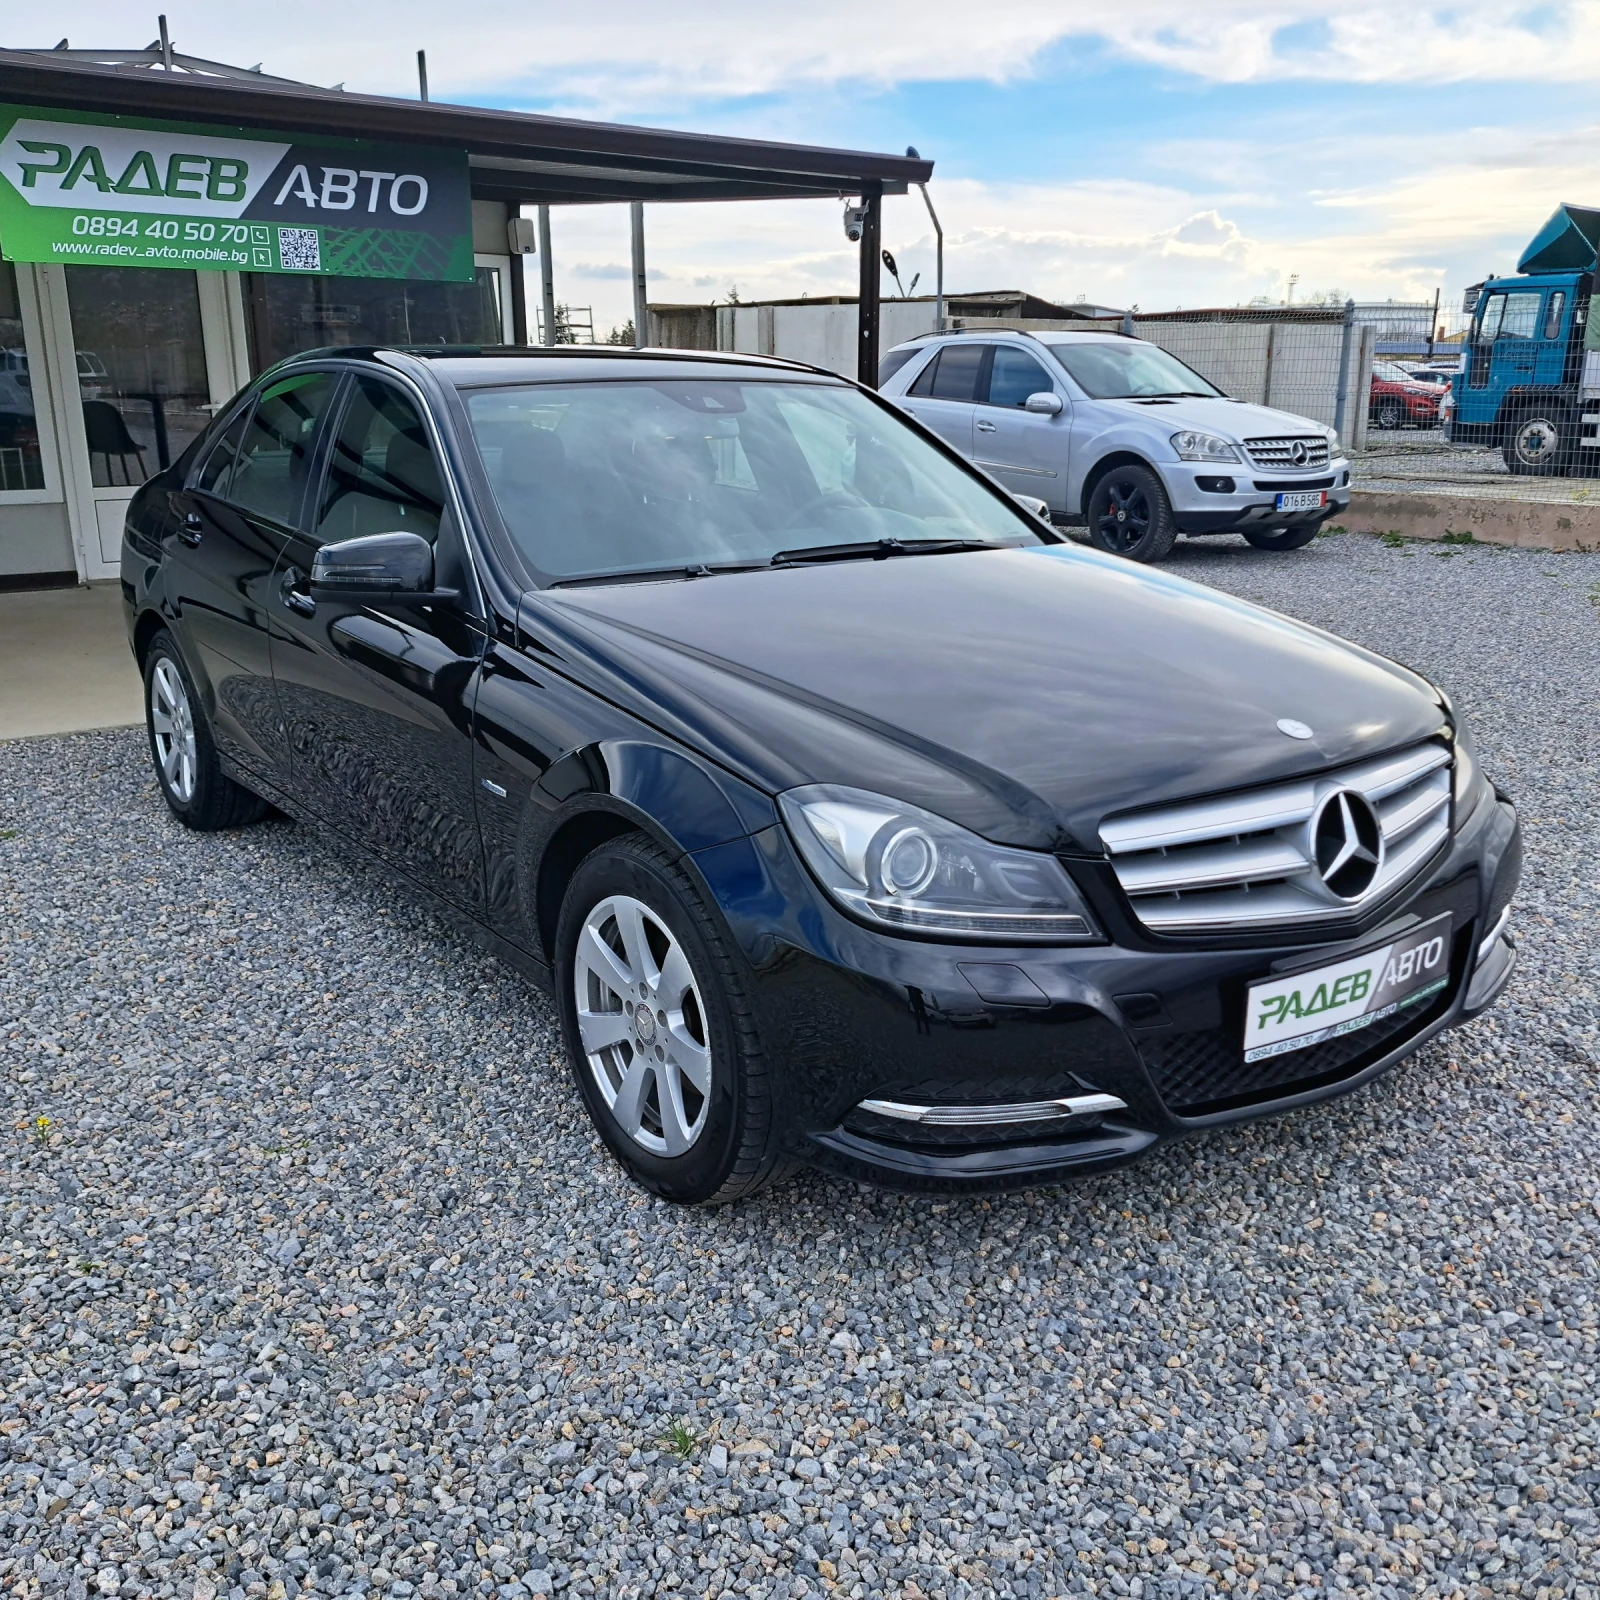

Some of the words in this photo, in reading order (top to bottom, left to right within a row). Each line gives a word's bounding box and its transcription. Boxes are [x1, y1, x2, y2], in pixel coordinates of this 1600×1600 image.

[16, 139, 249, 202] РАДЕВ
[273, 164, 430, 216] АВТО
[72, 215, 139, 238] 0894
[144, 220, 179, 240] 40
[183, 222, 216, 242] 50
[219, 224, 248, 244] 70
[52, 242, 249, 264] www.radev_avto.mobile.bg
[1258, 968, 1373, 1030] РАДЕВ
[1377, 936, 1444, 992] АВТО
[1248, 1046, 1272, 1061] 0894
[1273, 1041, 1287, 1053] 40
[1287, 1038, 1301, 1050] 50
[1301, 1035, 1314, 1046] 70
